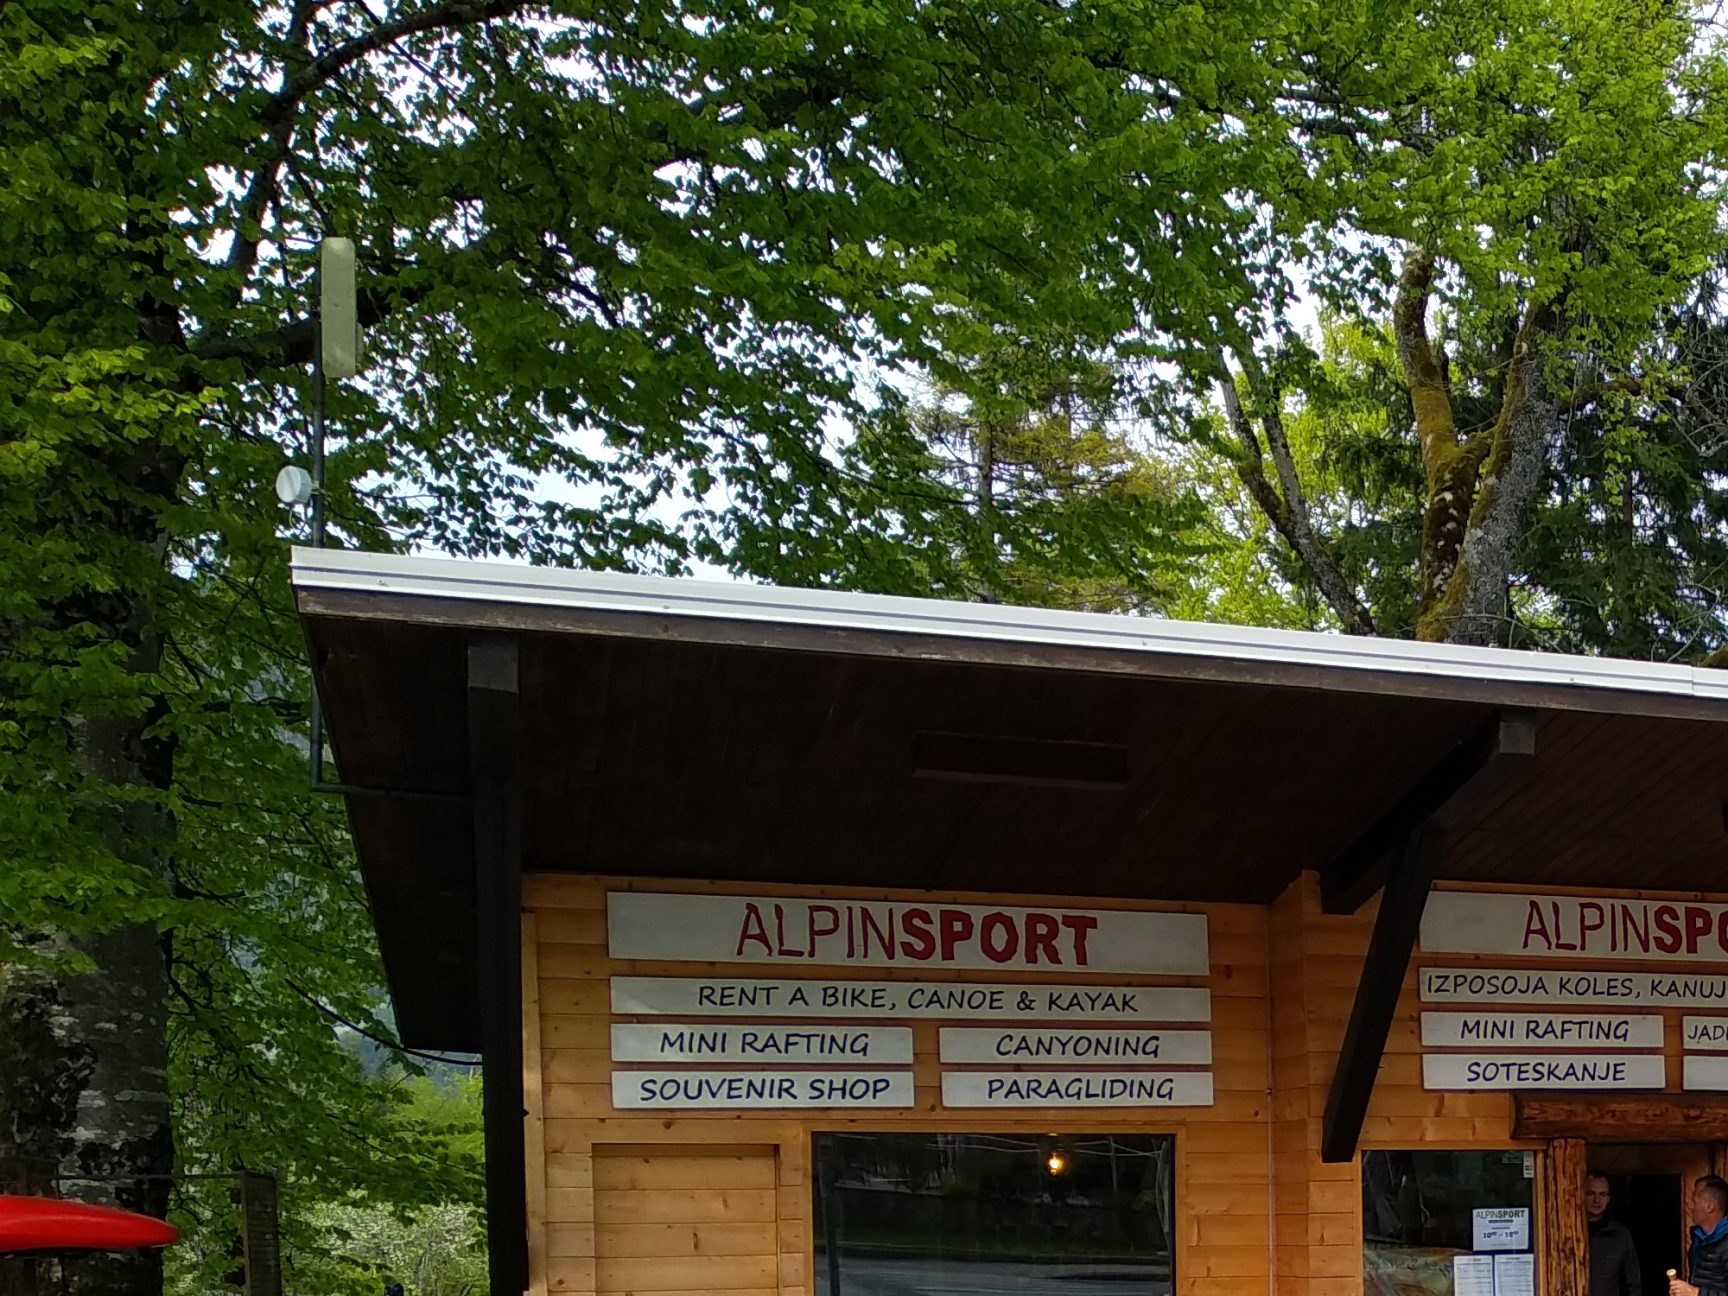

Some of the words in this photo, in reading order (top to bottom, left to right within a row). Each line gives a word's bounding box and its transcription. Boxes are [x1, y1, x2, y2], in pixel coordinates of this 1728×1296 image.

[737, 903, 1098, 966] ALPINSPORT
[1427, 974, 1549, 996] IZPOSOJA
[1559, 977, 1641, 999] KOLES,
[698, 985, 779, 1008] RENT
[788, 988, 809, 1008] A
[823, 987, 896, 1011] BIKE,
[908, 989, 1004, 1012] CANOE
[1017, 991, 1037, 1012] &
[1048, 991, 1139, 1013] KAYAK
[1461, 1020, 1514, 1040] MINI
[1526, 1020, 1630, 1041] RAFTING
[660, 1032, 727, 1056] MINI
[741, 1032, 869, 1057] RAFTING
[995, 1035, 1161, 1059] CANYONING
[1466, 1062, 1626, 1083] SOTESKANJE
[640, 1079, 798, 1102] SOUVENIR
[809, 1078, 890, 1102] SHOP
[987, 1078, 1175, 1102] PARAGLIDING
[1475, 1210, 1525, 1219] ALPINSPORT
